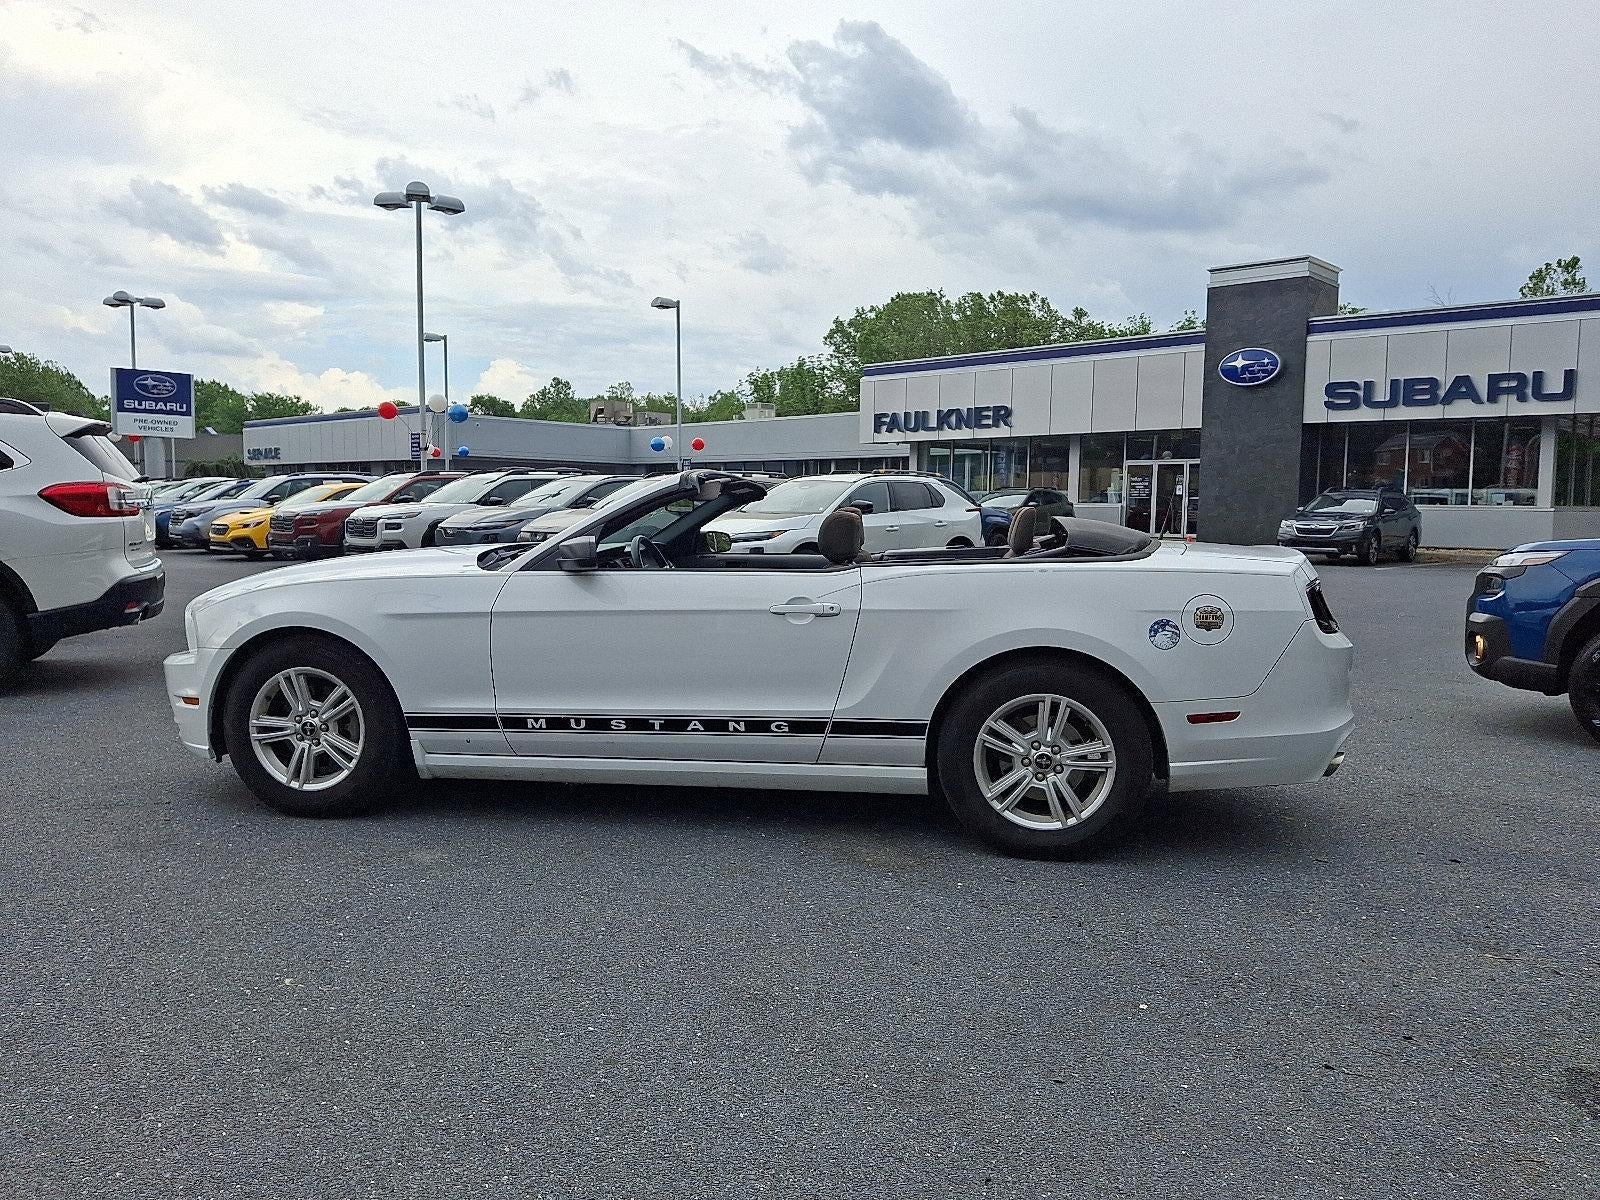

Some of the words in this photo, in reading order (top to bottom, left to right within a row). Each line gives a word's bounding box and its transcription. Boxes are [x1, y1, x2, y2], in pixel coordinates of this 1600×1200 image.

[1324, 369, 1577, 410] SUBARU
[123, 399, 187, 412] SUBARU
[133, 418, 179, 427] PRE-OWNED
[873, 405, 1013, 434] FAULKNER
[138, 425, 175, 433] VEHICLES
[526, 718, 790, 732] MUSTANG
